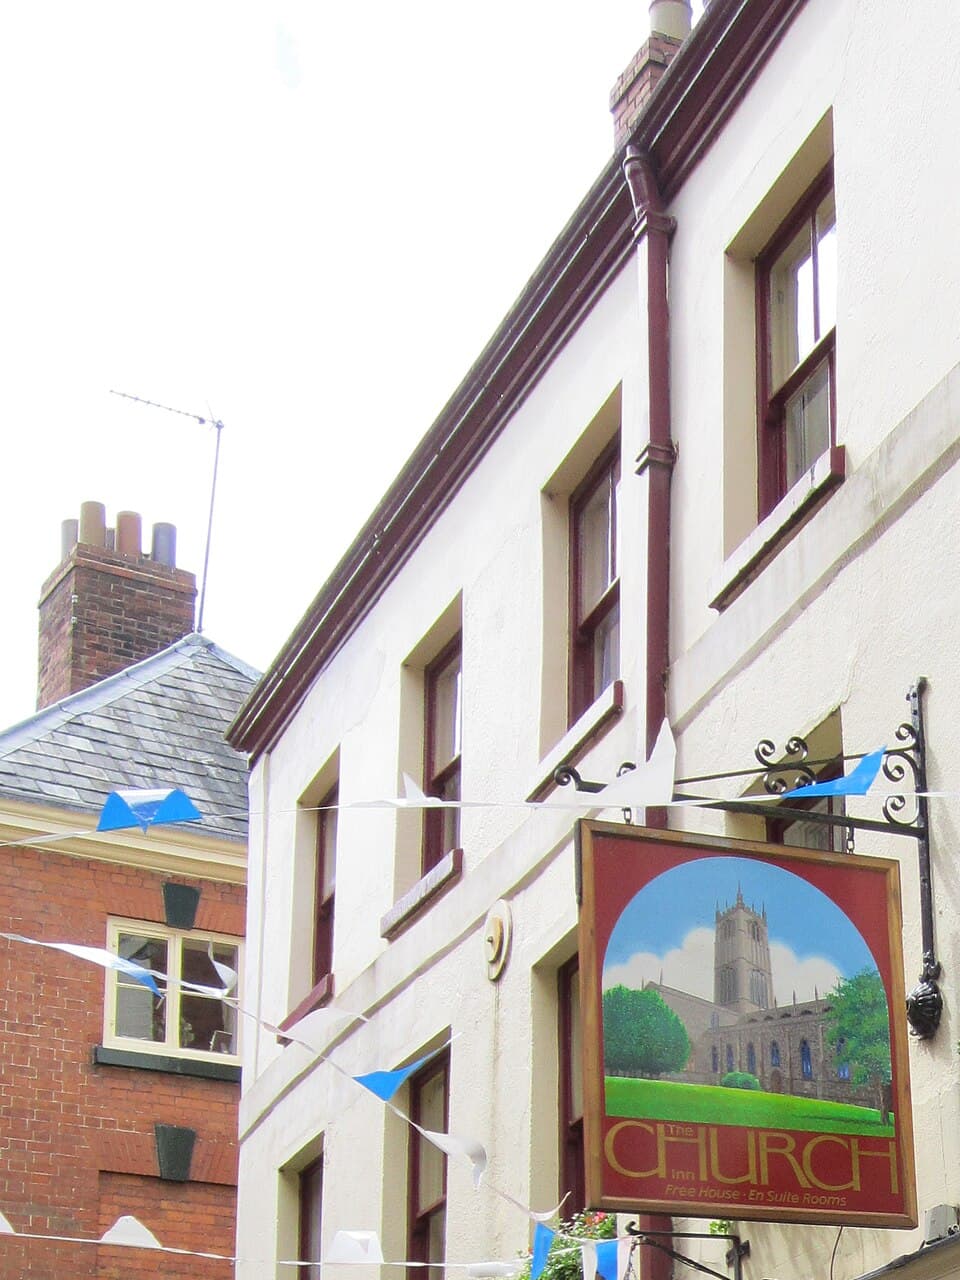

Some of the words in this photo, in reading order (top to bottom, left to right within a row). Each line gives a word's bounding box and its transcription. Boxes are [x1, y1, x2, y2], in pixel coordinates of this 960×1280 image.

[667, 1124, 693, 1136] The
[604, 1120, 899, 1194] CHURCH
[672, 1169, 695, 1181] Inn
[665, 1184, 696, 1197] Free
[700, 1186, 740, 1200] House
[748, 1189, 764, 1201] En
[768, 1190, 799, 1203] Suite
[803, 1193, 847, 1207] Rooms
